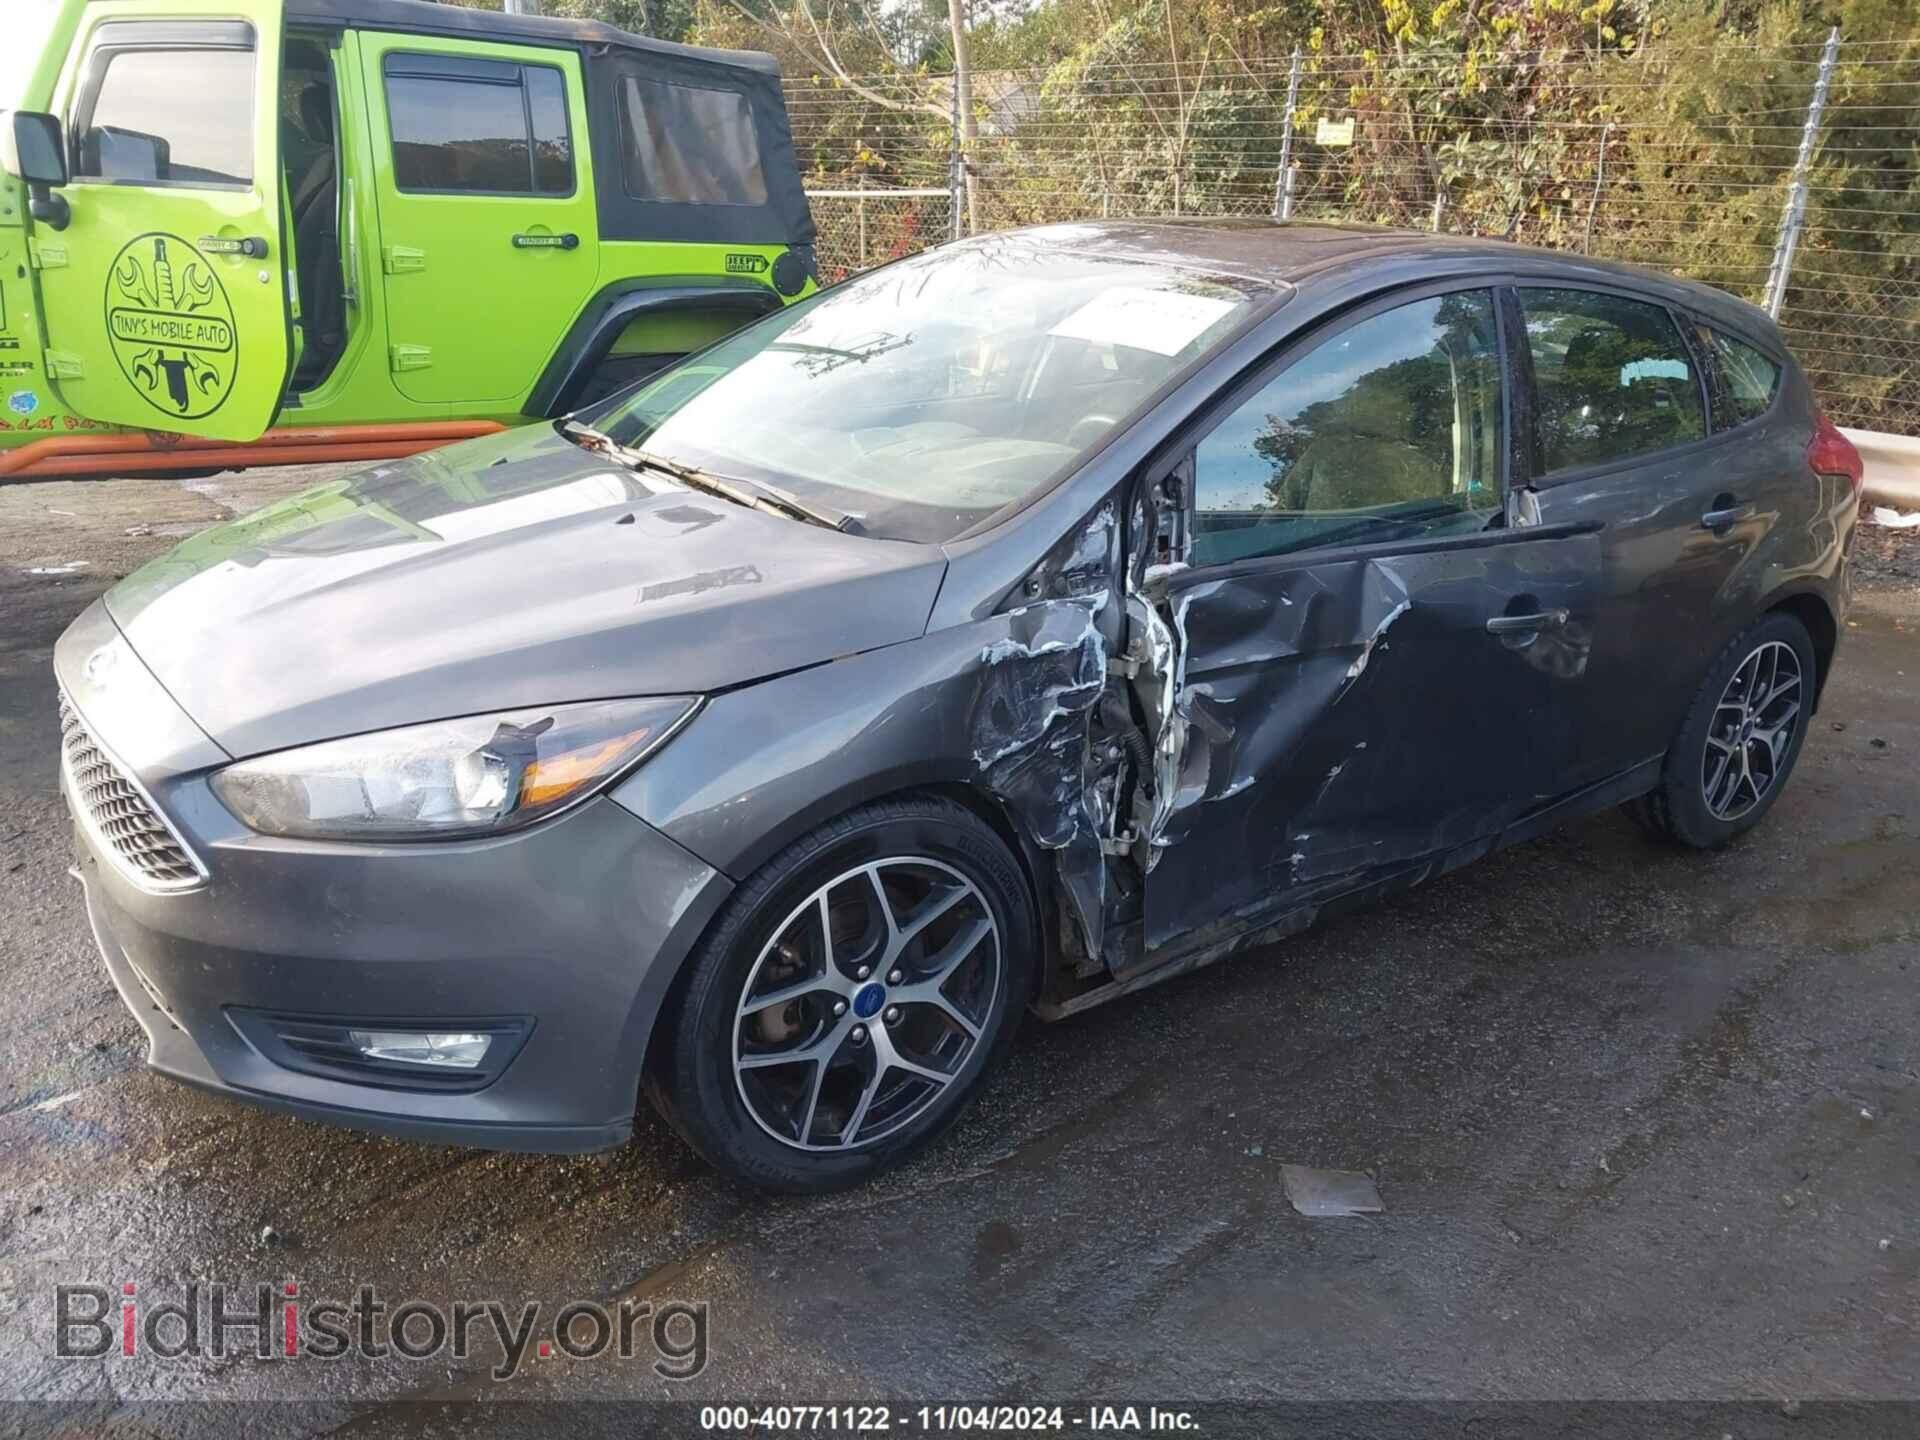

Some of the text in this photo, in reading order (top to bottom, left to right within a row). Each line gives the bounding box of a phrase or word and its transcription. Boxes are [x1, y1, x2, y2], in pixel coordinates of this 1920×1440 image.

[114, 315, 228, 344] TINY'S MOBILE AUTO
